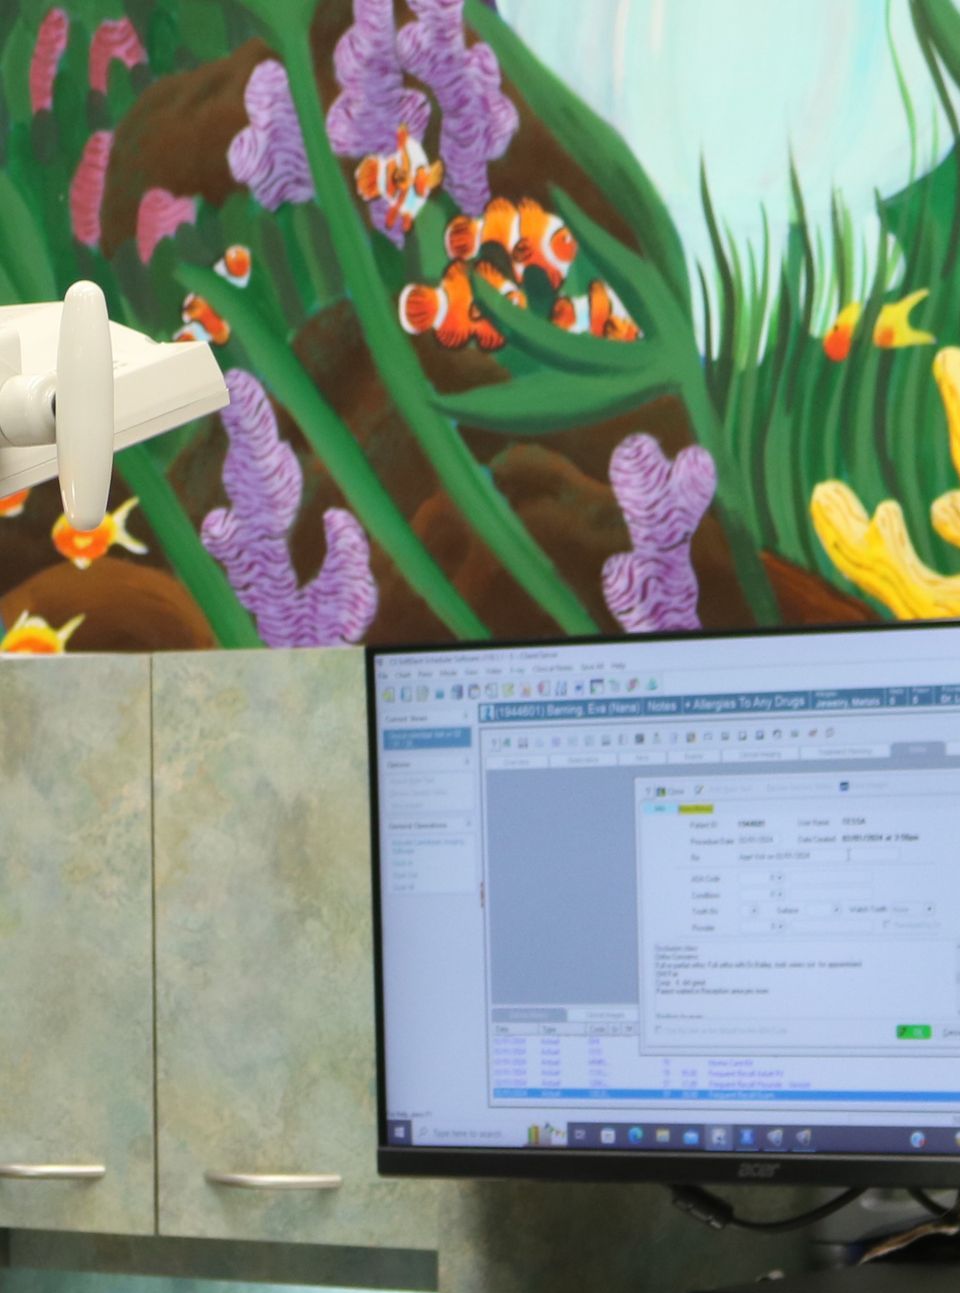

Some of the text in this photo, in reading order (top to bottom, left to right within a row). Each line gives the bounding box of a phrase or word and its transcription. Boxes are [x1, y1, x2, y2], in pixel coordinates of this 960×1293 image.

[647, 699, 677, 712] Notes
[692, 694, 805, 712] Allergies To Any Drugs
